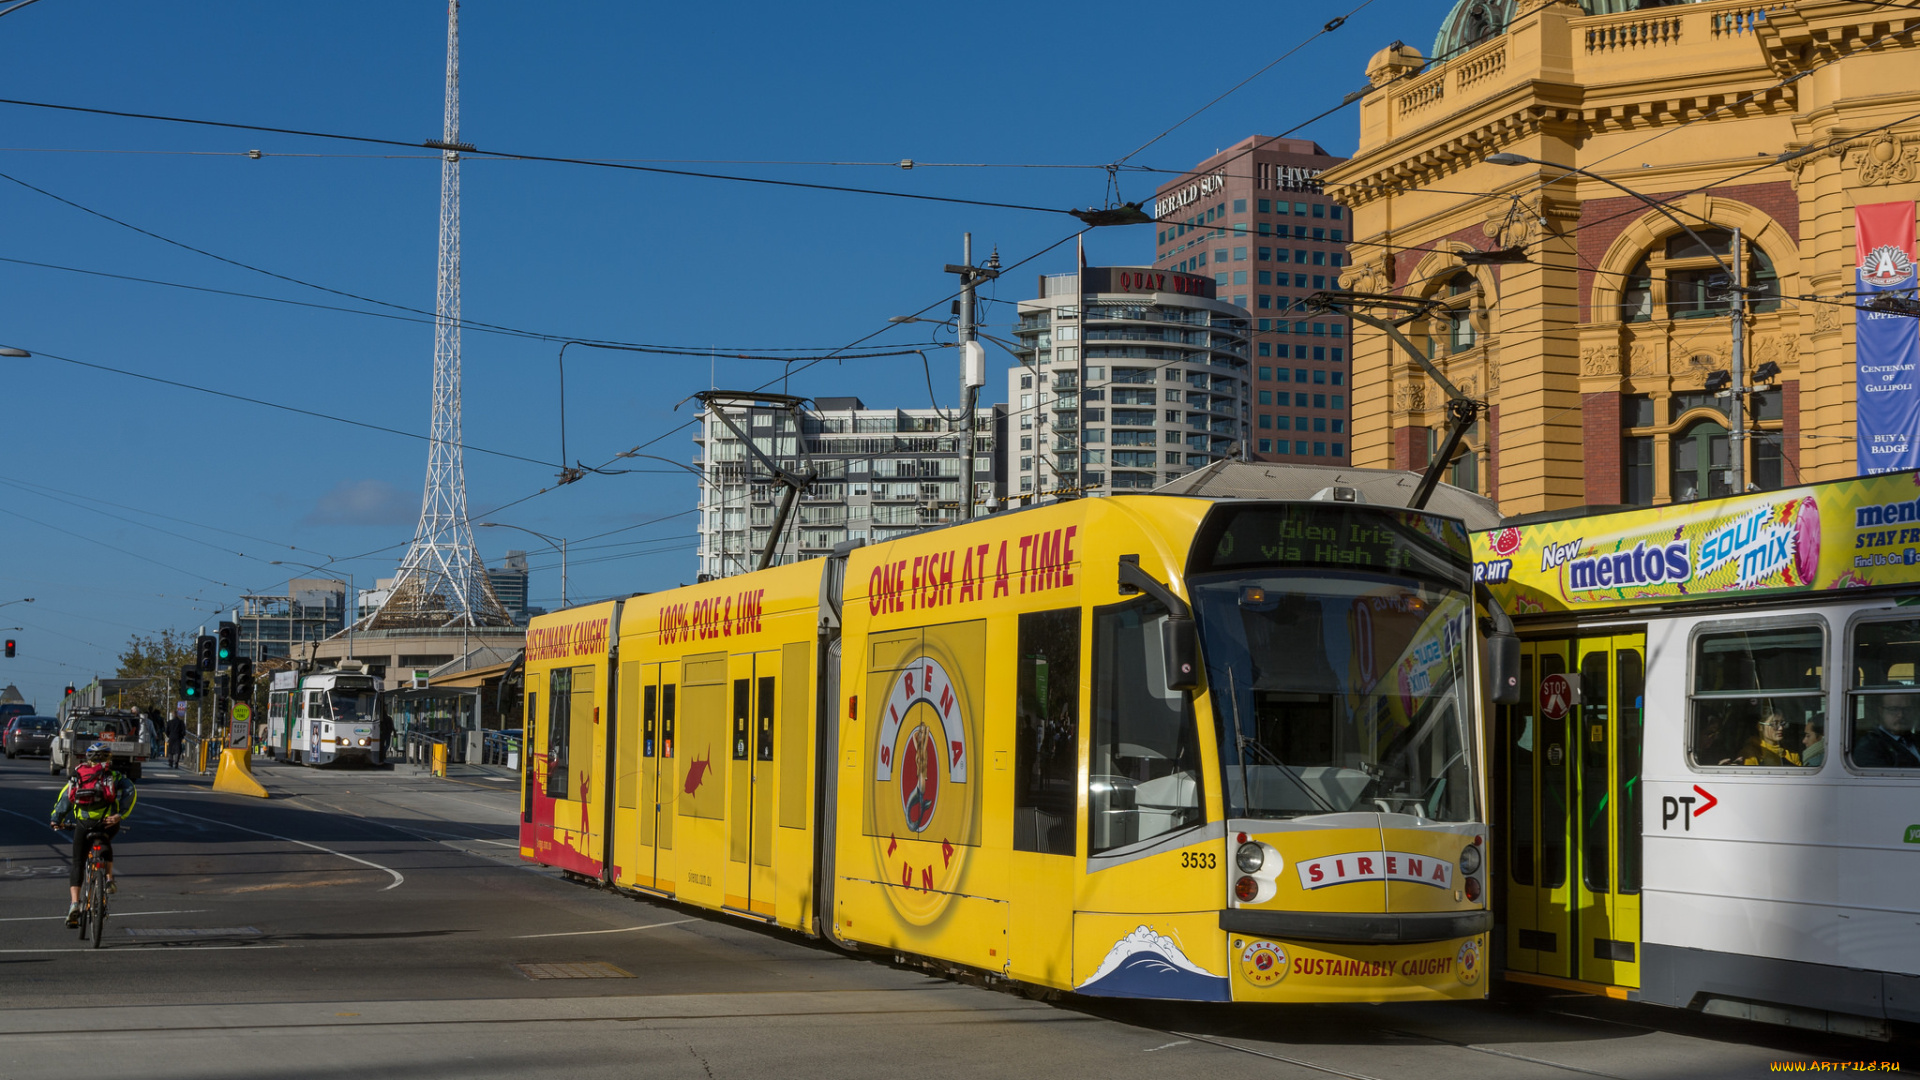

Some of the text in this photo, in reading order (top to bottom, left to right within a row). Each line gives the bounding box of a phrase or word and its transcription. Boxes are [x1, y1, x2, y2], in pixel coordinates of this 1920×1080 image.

[1154, 172, 1225, 219] HERALD SUN
[1876, 251, 1896, 277] A
[1120, 272, 1164, 292] QUAY
[1861, 364, 1916, 373] CENTENARY
[1882, 374, 1895, 382] OF
[1865, 383, 1912, 393] GALLIPOLI
[1871, 444, 1909, 454] BADGE
[1874, 433, 1906, 443] BUY A
[1279, 519, 1396, 545] Glen Iris
[1699, 507, 1769, 571] sour
[1855, 530, 1897, 548] STAY
[1261, 542, 1411, 568] via High St
[1541, 537, 1583, 573] New
[1569, 540, 1692, 592] mentos
[1742, 529, 1792, 582] mix
[1854, 554, 1873, 567] Find
[1875, 553, 1886, 565] Us
[1888, 552, 1902, 564] On
[868, 525, 1078, 617] ONE FISH AT A TIME
[1486, 560, 1511, 583] HIT
[658, 588, 765, 646] 100% POLE & LINE
[525, 617, 609, 663] SUSTAINABLY CAUGHT
[1543, 681, 1567, 695] STOP
[880, 664, 964, 769] SIRENA
[1662, 796, 1696, 831] PT
[887, 832, 955, 895] TUNA
[1181, 851, 1217, 870] 3533
[1308, 856, 1446, 883] SIRENA
[1245, 943, 1285, 961] SIRENA
[1248, 970, 1280, 981] TUNA
[1293, 956, 1453, 977] SUSTAINABLY CAUGHT
